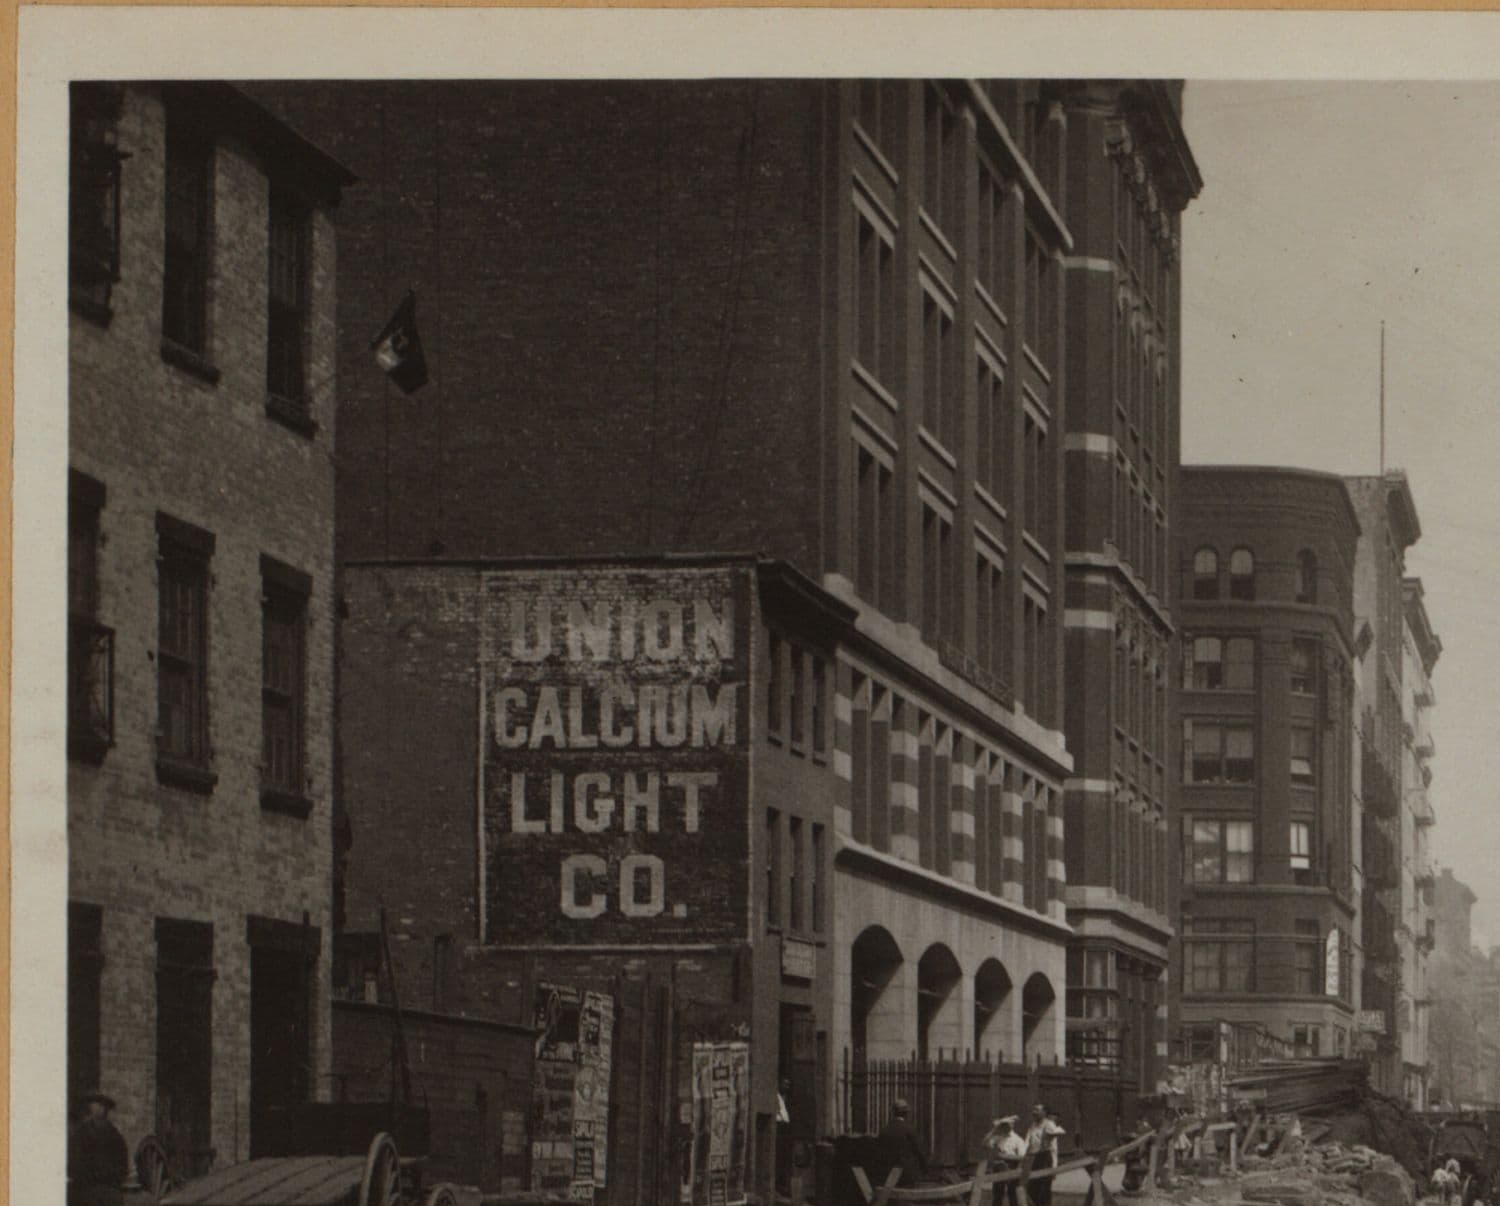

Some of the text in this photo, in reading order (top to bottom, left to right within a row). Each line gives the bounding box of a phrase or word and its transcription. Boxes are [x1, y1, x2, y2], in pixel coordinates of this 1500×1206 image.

[509, 597, 735, 662] UNION
[494, 682, 742, 749] CALCIUM
[511, 771, 719, 834] LIGHT
[559, 853, 688, 920] CO.
